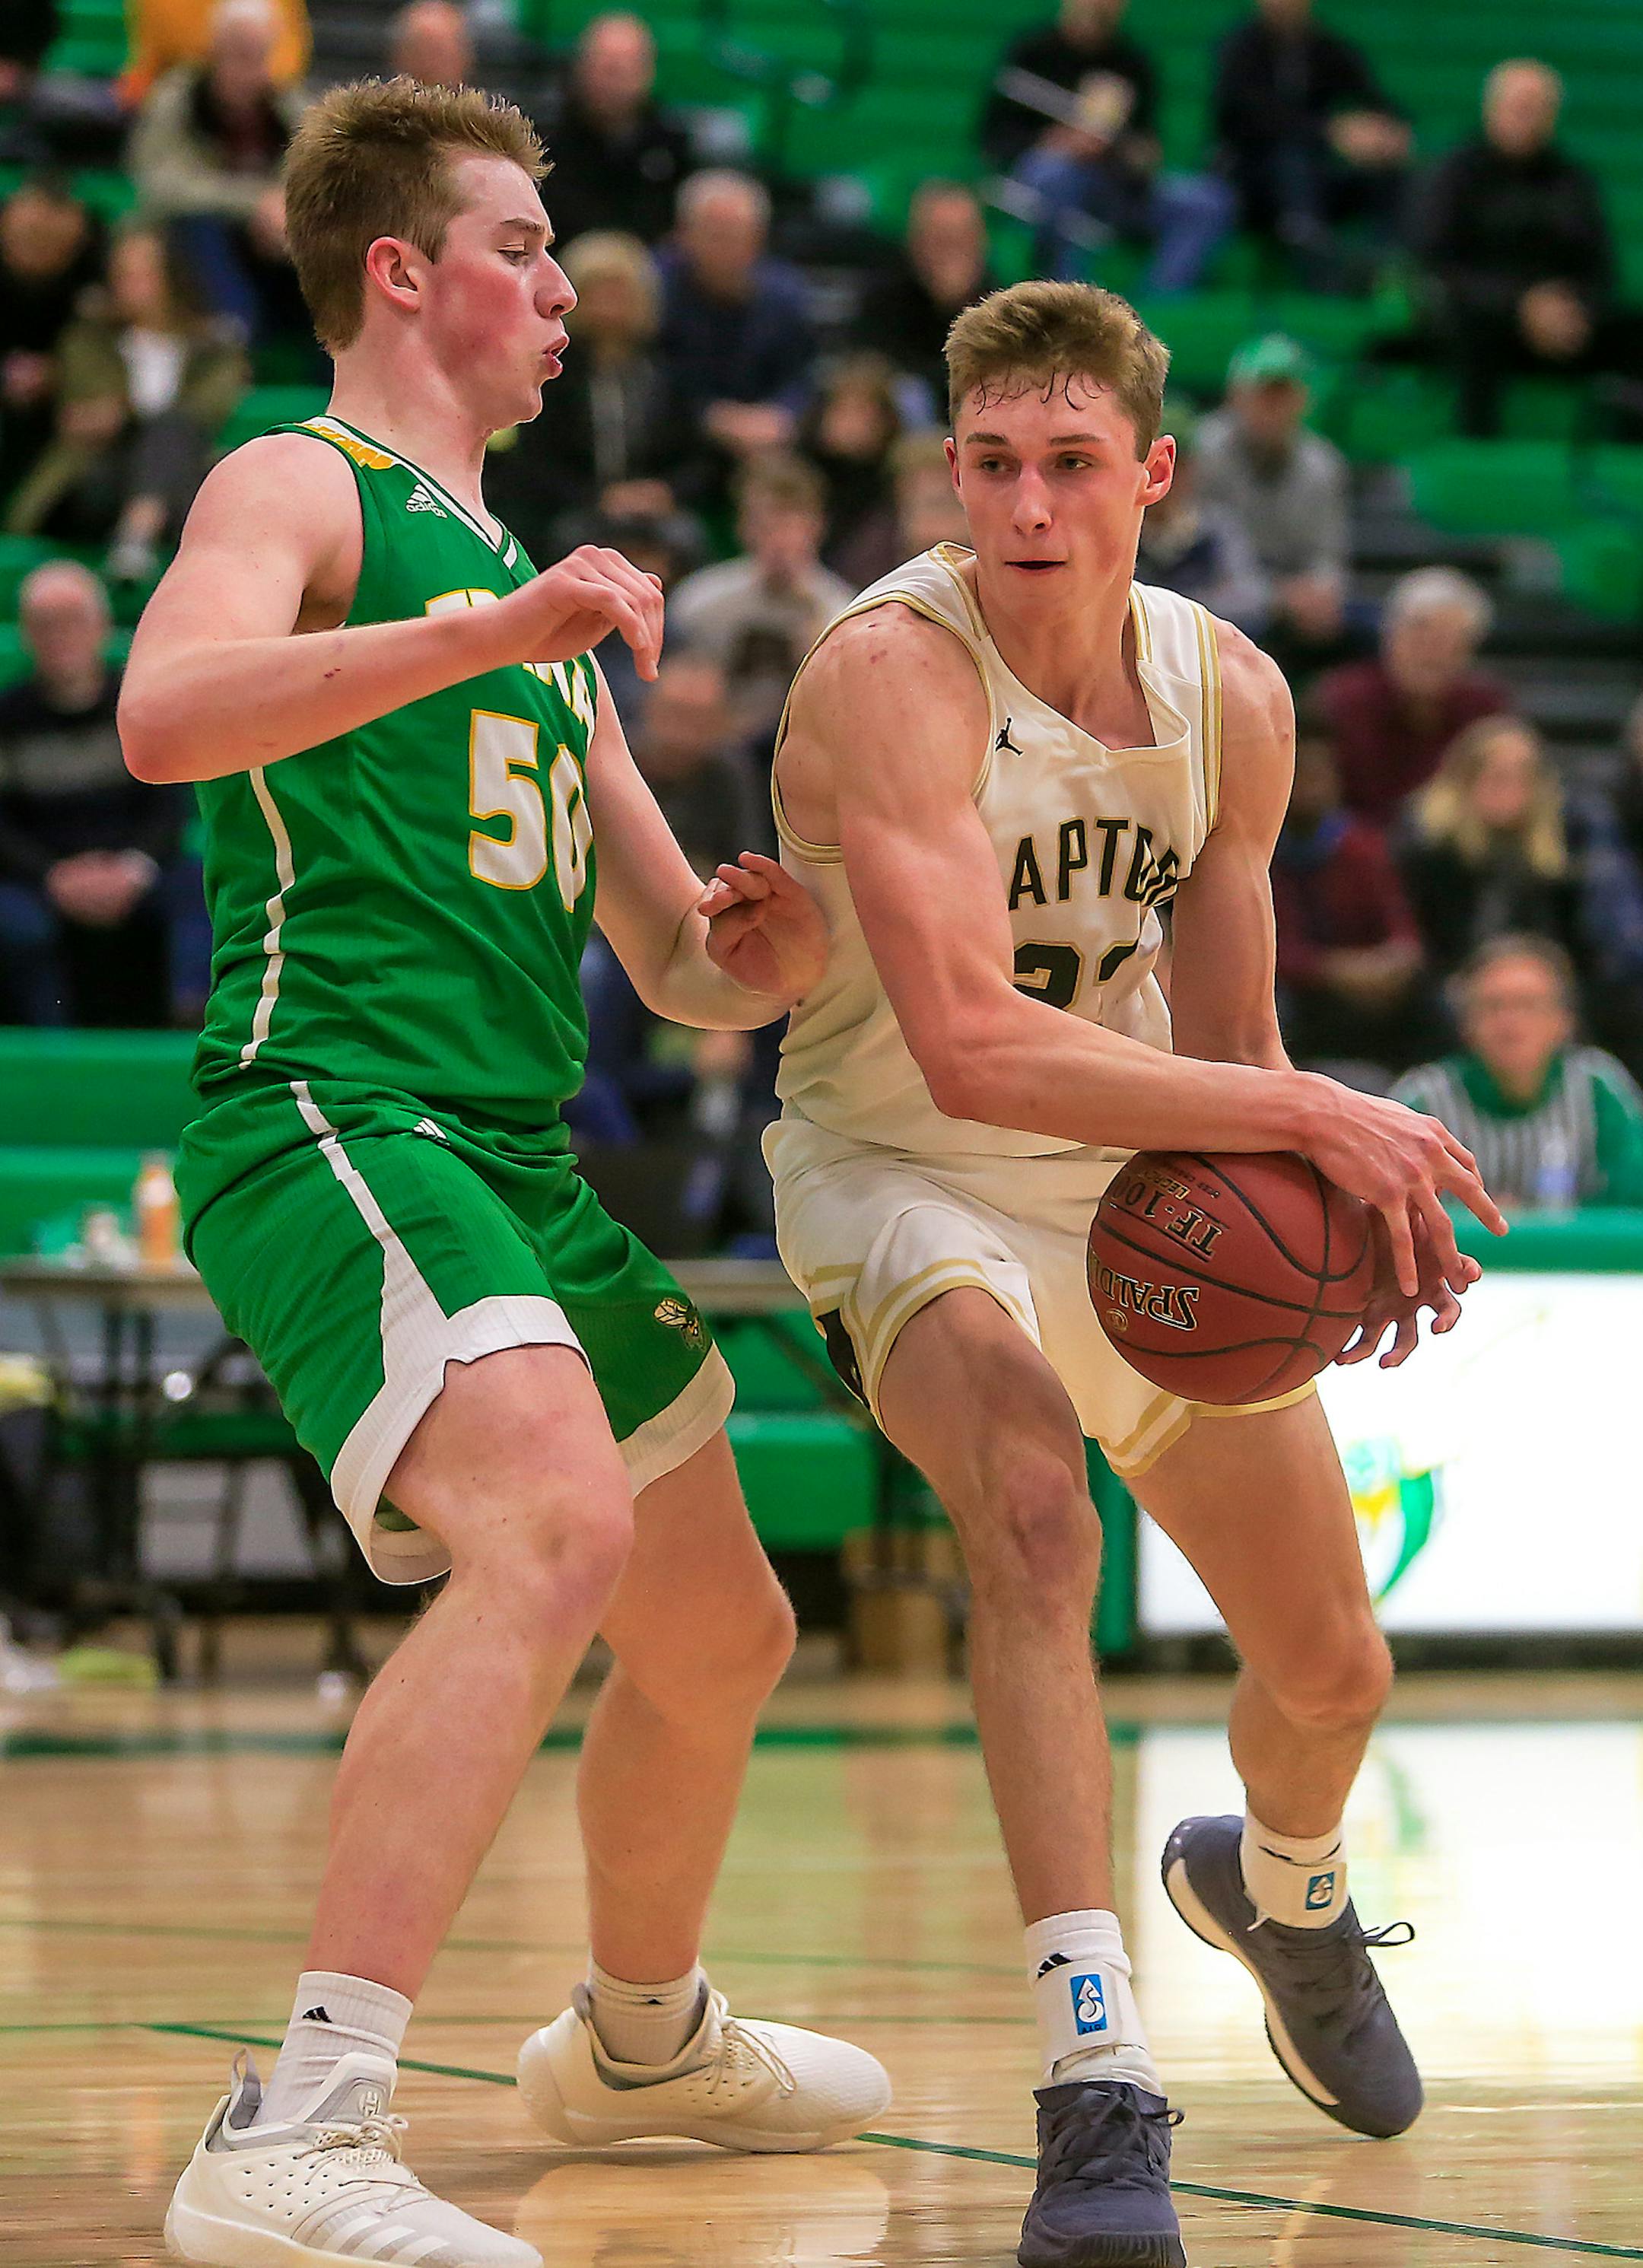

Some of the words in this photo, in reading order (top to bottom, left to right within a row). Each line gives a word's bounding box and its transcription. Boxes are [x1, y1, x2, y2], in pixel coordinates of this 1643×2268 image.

[405, 500, 449, 520] adidas
[469, 708, 594, 914] 50
[1013, 939, 1141, 1013] 2
